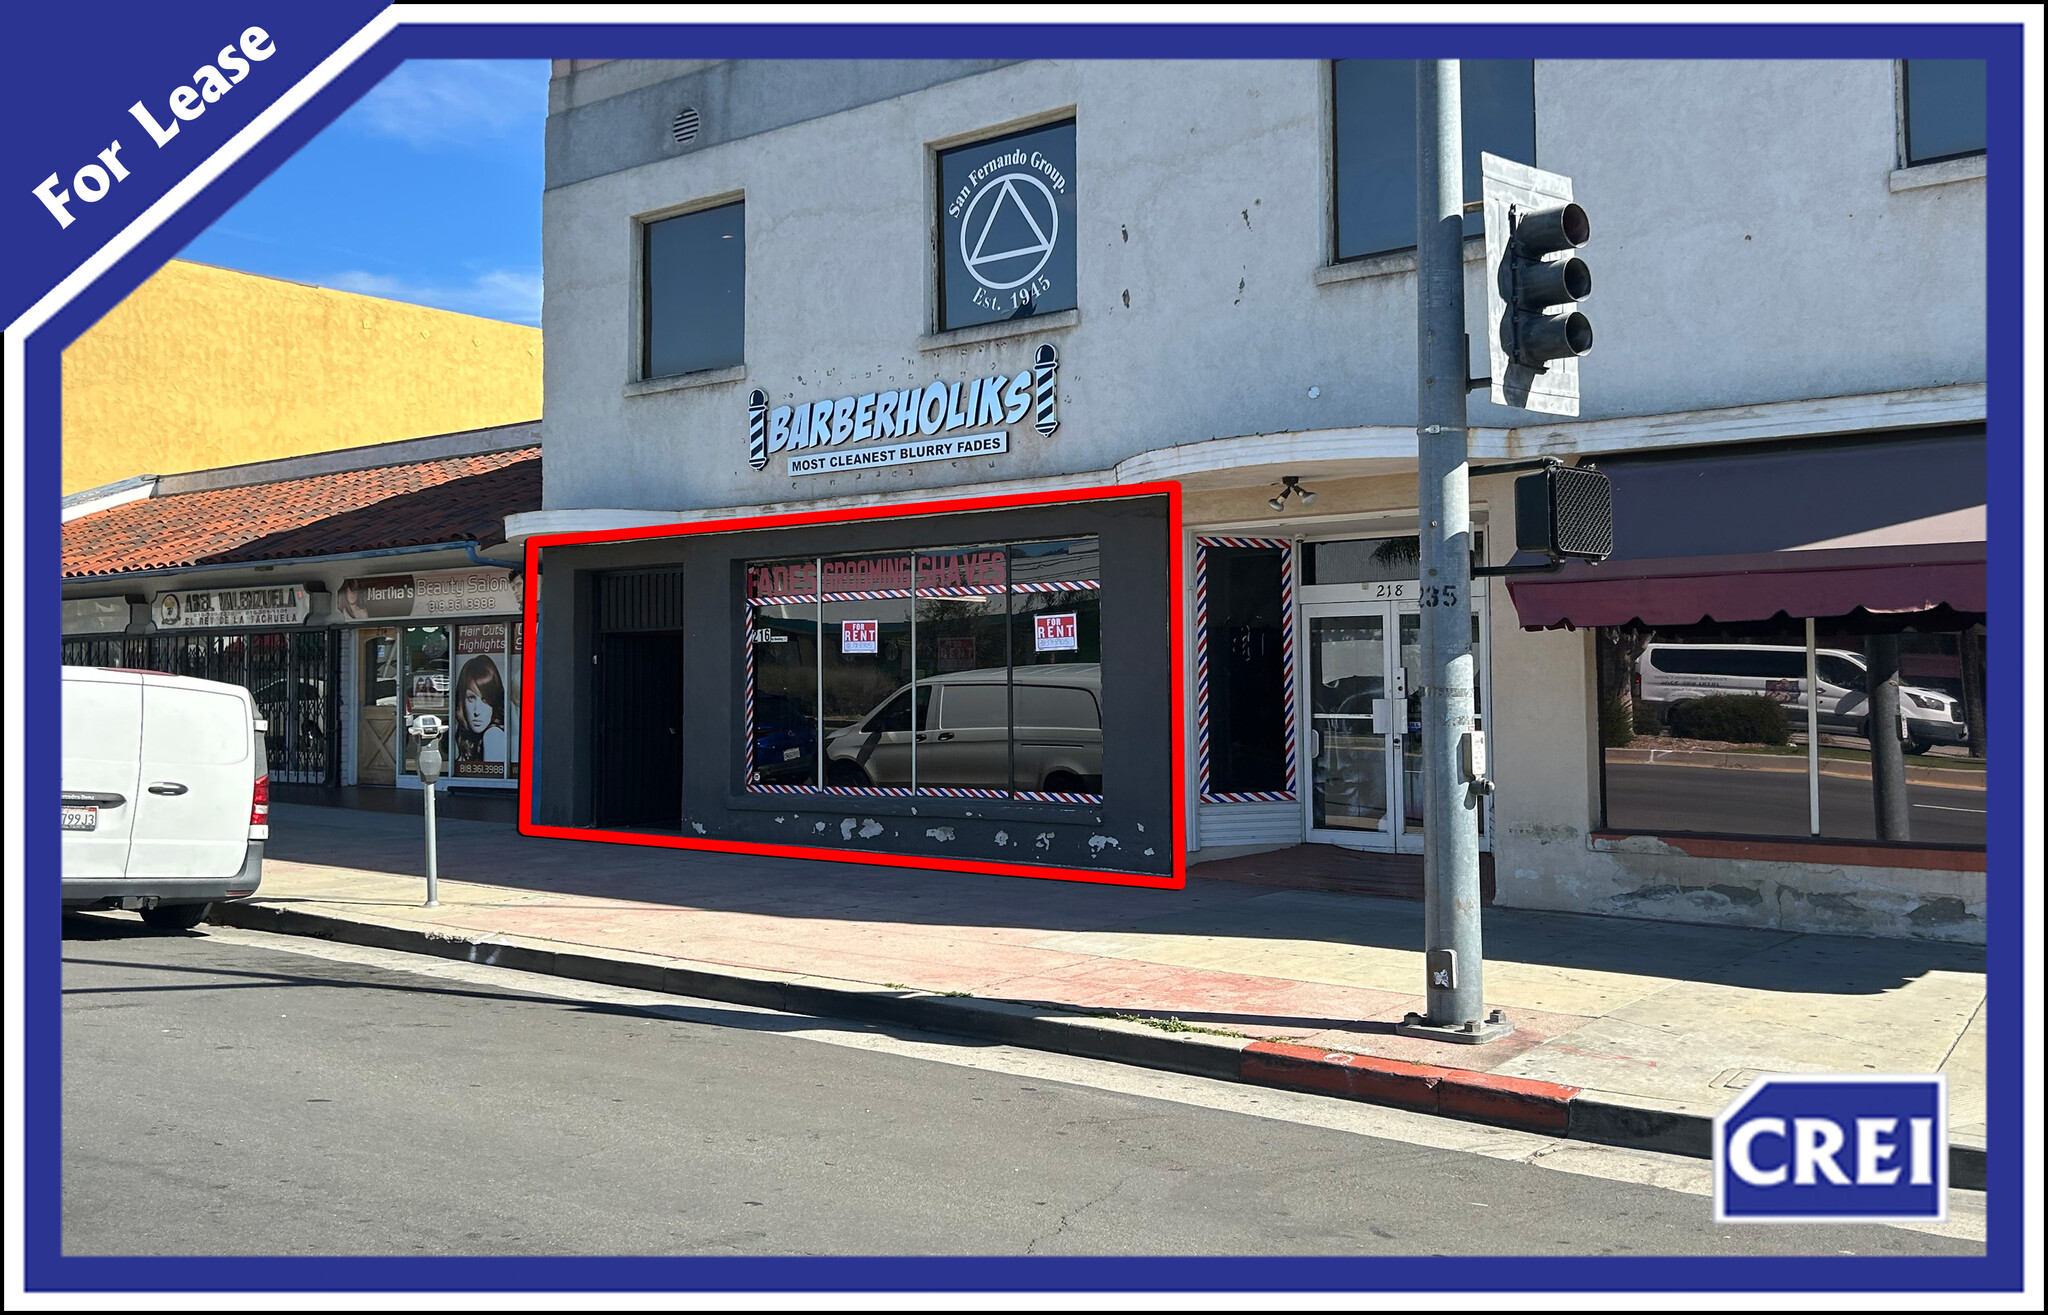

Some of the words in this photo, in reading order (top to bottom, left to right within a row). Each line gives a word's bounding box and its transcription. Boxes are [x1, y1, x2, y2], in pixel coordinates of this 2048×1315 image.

[948, 186, 971, 219] San
[968, 149, 1027, 188] Fernando
[1030, 151, 1067, 194] Group.
[972, 287, 1001, 311] Est.
[1010, 274, 1051, 309] 1945
[768, 370, 1032, 453] BARBERHOLIKS
[792, 458, 827, 472] MOST
[829, 450, 895, 468] CLEANEST
[900, 444, 952, 460] BLURRY
[957, 437, 1001, 453] FADES
[747, 563, 817, 598] FADES
[823, 557, 911, 592] GROOMING
[917, 551, 1006, 588] SHAVES
[367, 584, 414, 601] Martha's
[417, 578, 464, 597] Beauty
[467, 575, 508, 593] Salon
[1376, 584, 1404, 598] 218
[185, 593, 215, 613] ABEL
[218, 588, 297, 612] VALENZUELA
[427, 597, 496, 612] 818.361.3988
[185, 617, 195, 626] EL
[200, 616, 214, 626] REY
[219, 616, 229, 625] DE
[233, 615, 245, 624] LA
[251, 613, 297, 624] TACHUELA
[852, 623, 865, 631] FOR
[1046, 618, 1061, 626] FOR
[460, 625, 480, 637] Hair
[482, 624, 505, 636] Cuts
[752, 629, 770, 642] 216
[845, 630, 875, 642] RENT
[1038, 624, 1074, 639] RENT
[458, 638, 506, 652] Highlights
